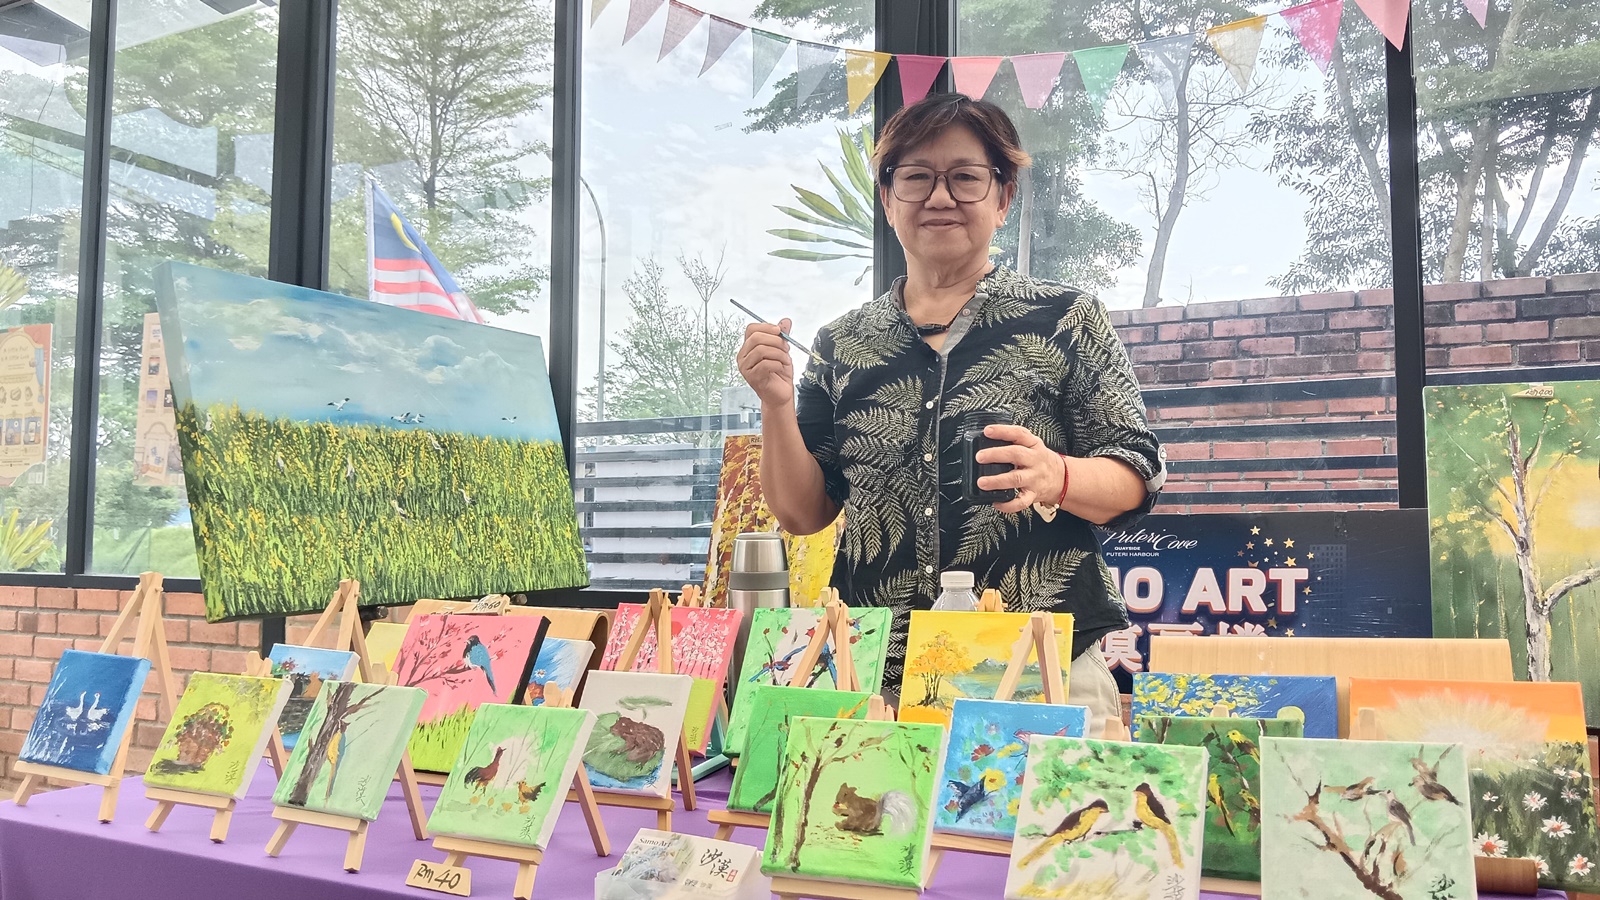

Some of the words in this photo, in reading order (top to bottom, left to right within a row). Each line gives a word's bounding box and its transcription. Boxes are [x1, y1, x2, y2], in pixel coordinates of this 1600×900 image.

[1153, 534, 1198, 551] Cove
[1181, 567, 1309, 615] ART
[639, 838, 659, 846] Samo
[659, 840, 672, 848] Art
[434, 869, 461, 890] 40
